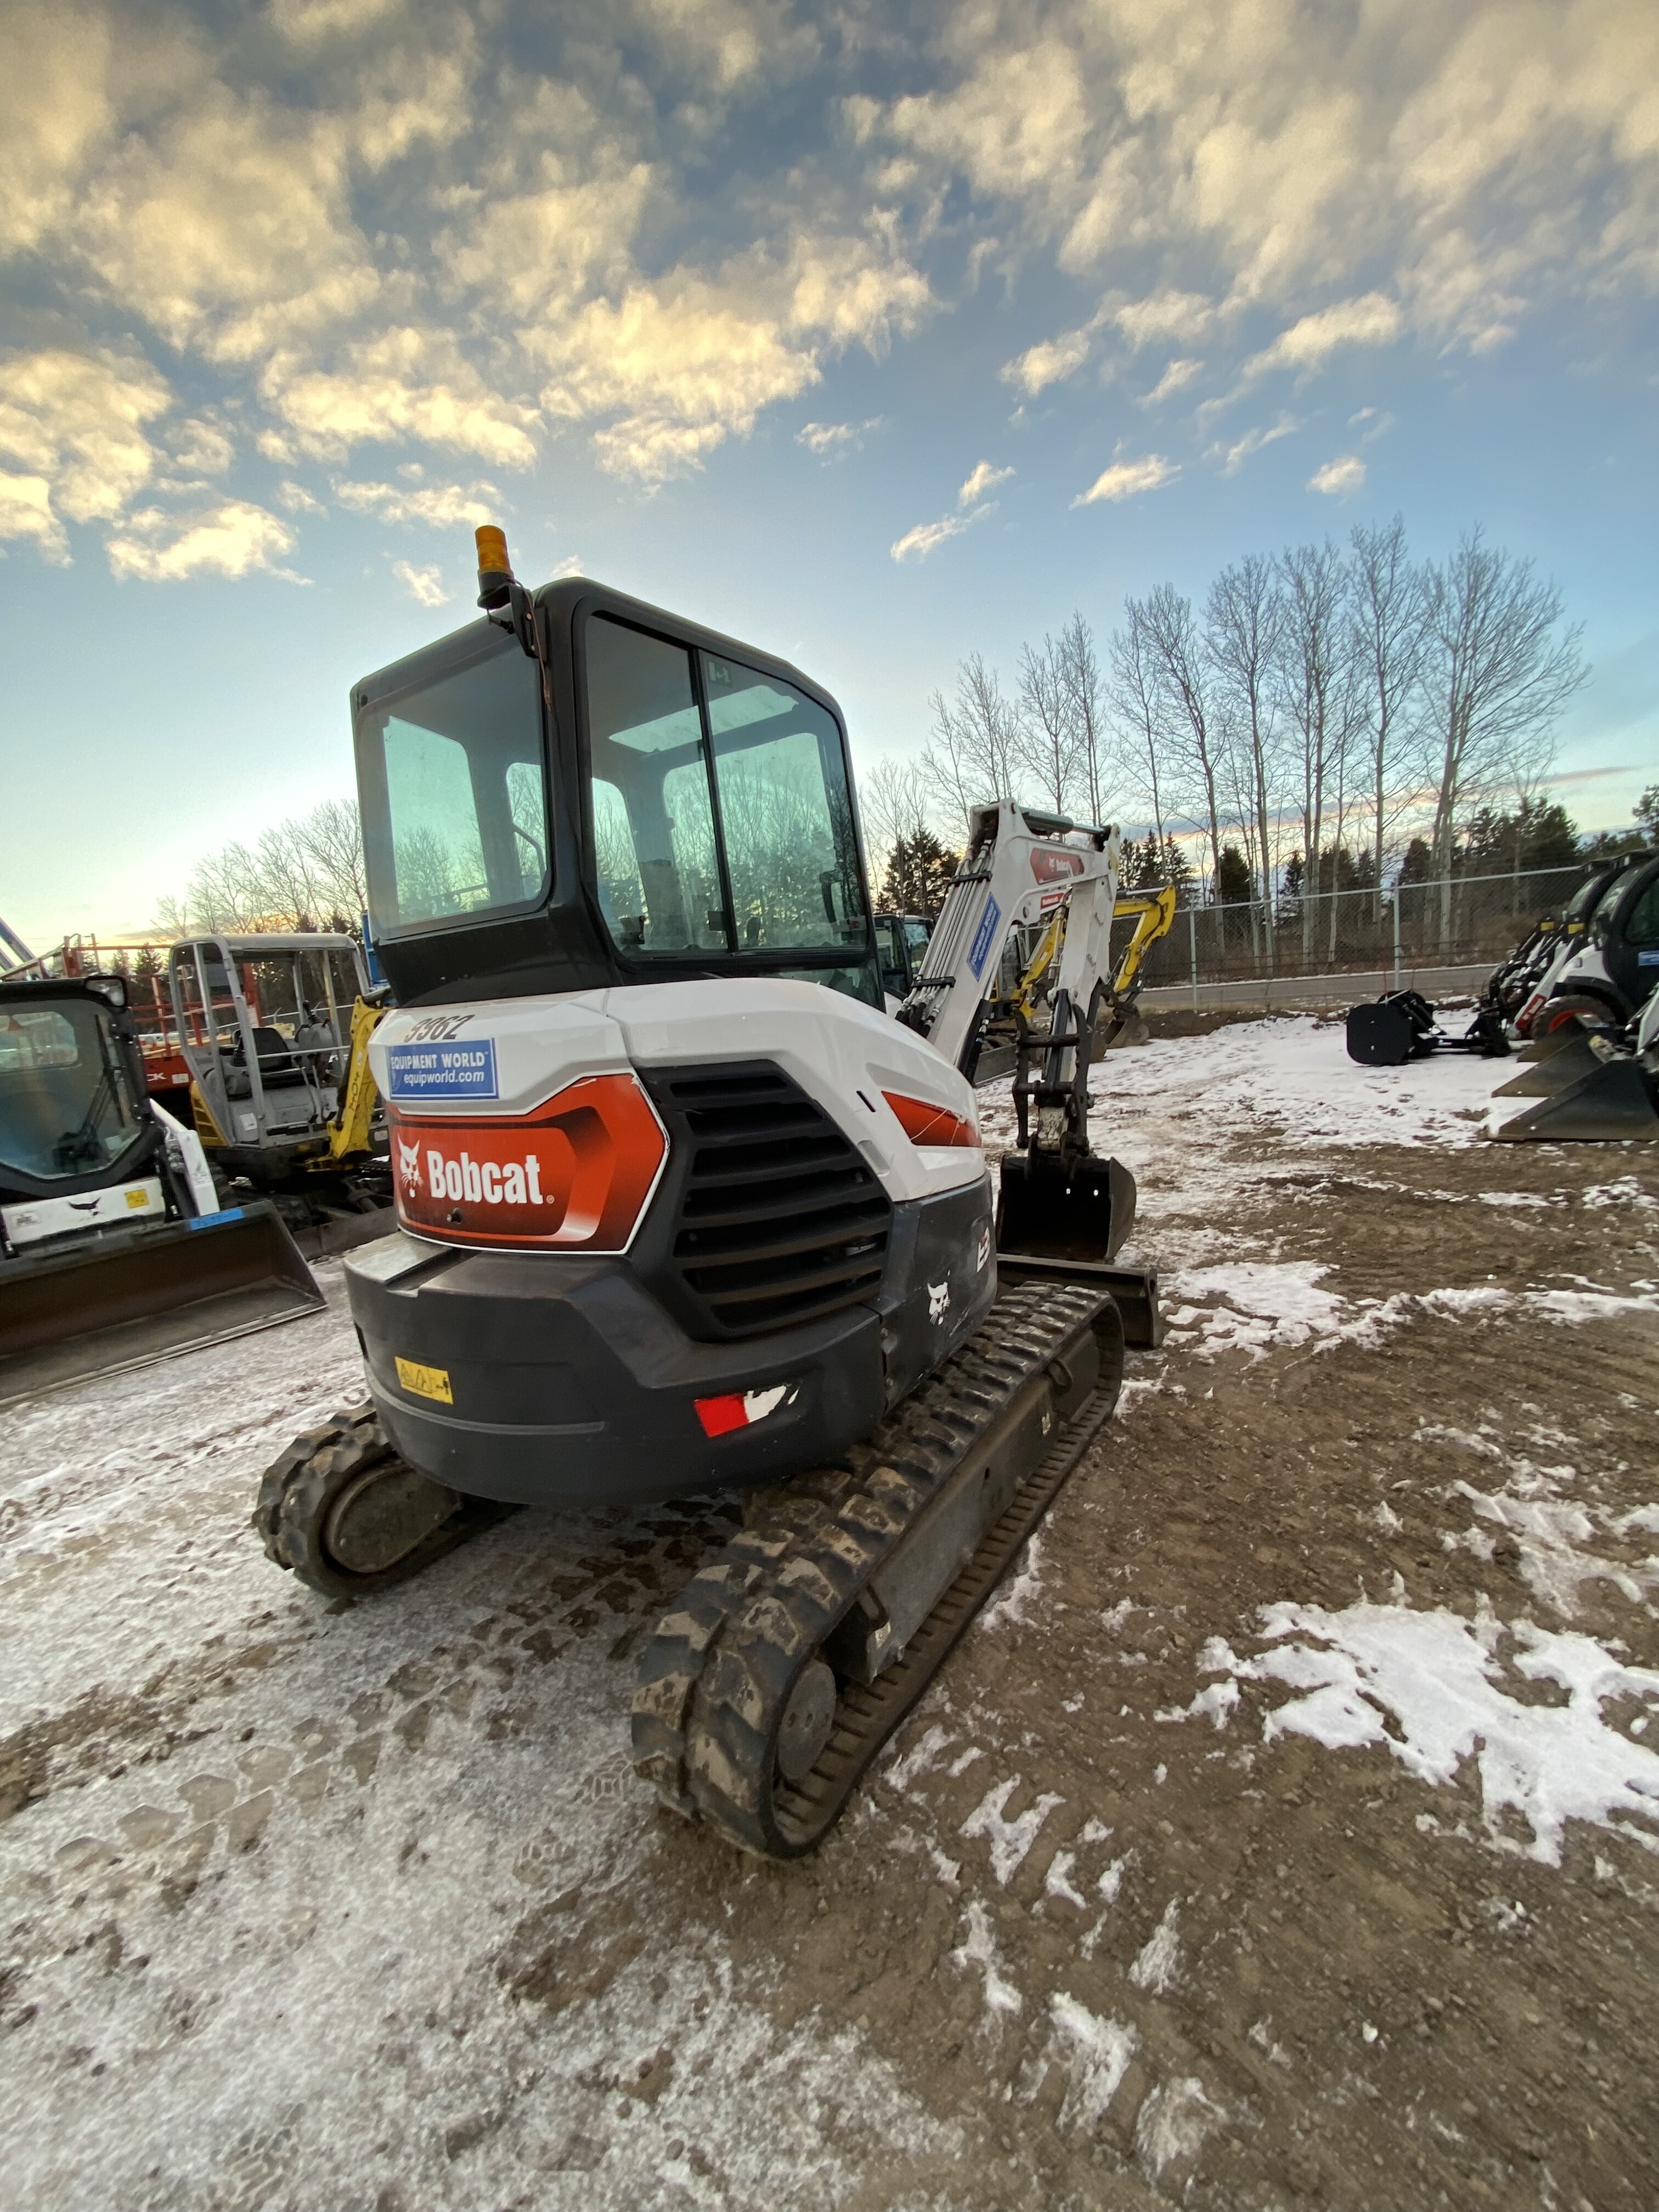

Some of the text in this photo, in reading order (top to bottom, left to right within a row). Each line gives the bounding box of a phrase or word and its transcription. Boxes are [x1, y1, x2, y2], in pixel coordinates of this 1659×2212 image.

[404, 1014, 476, 1042] 9962
[391, 1051, 486, 1070] EQUIPMENT WORLD
[403, 1070, 485, 1087] equipworld.com
[426, 1150, 544, 1205] Bobcat
